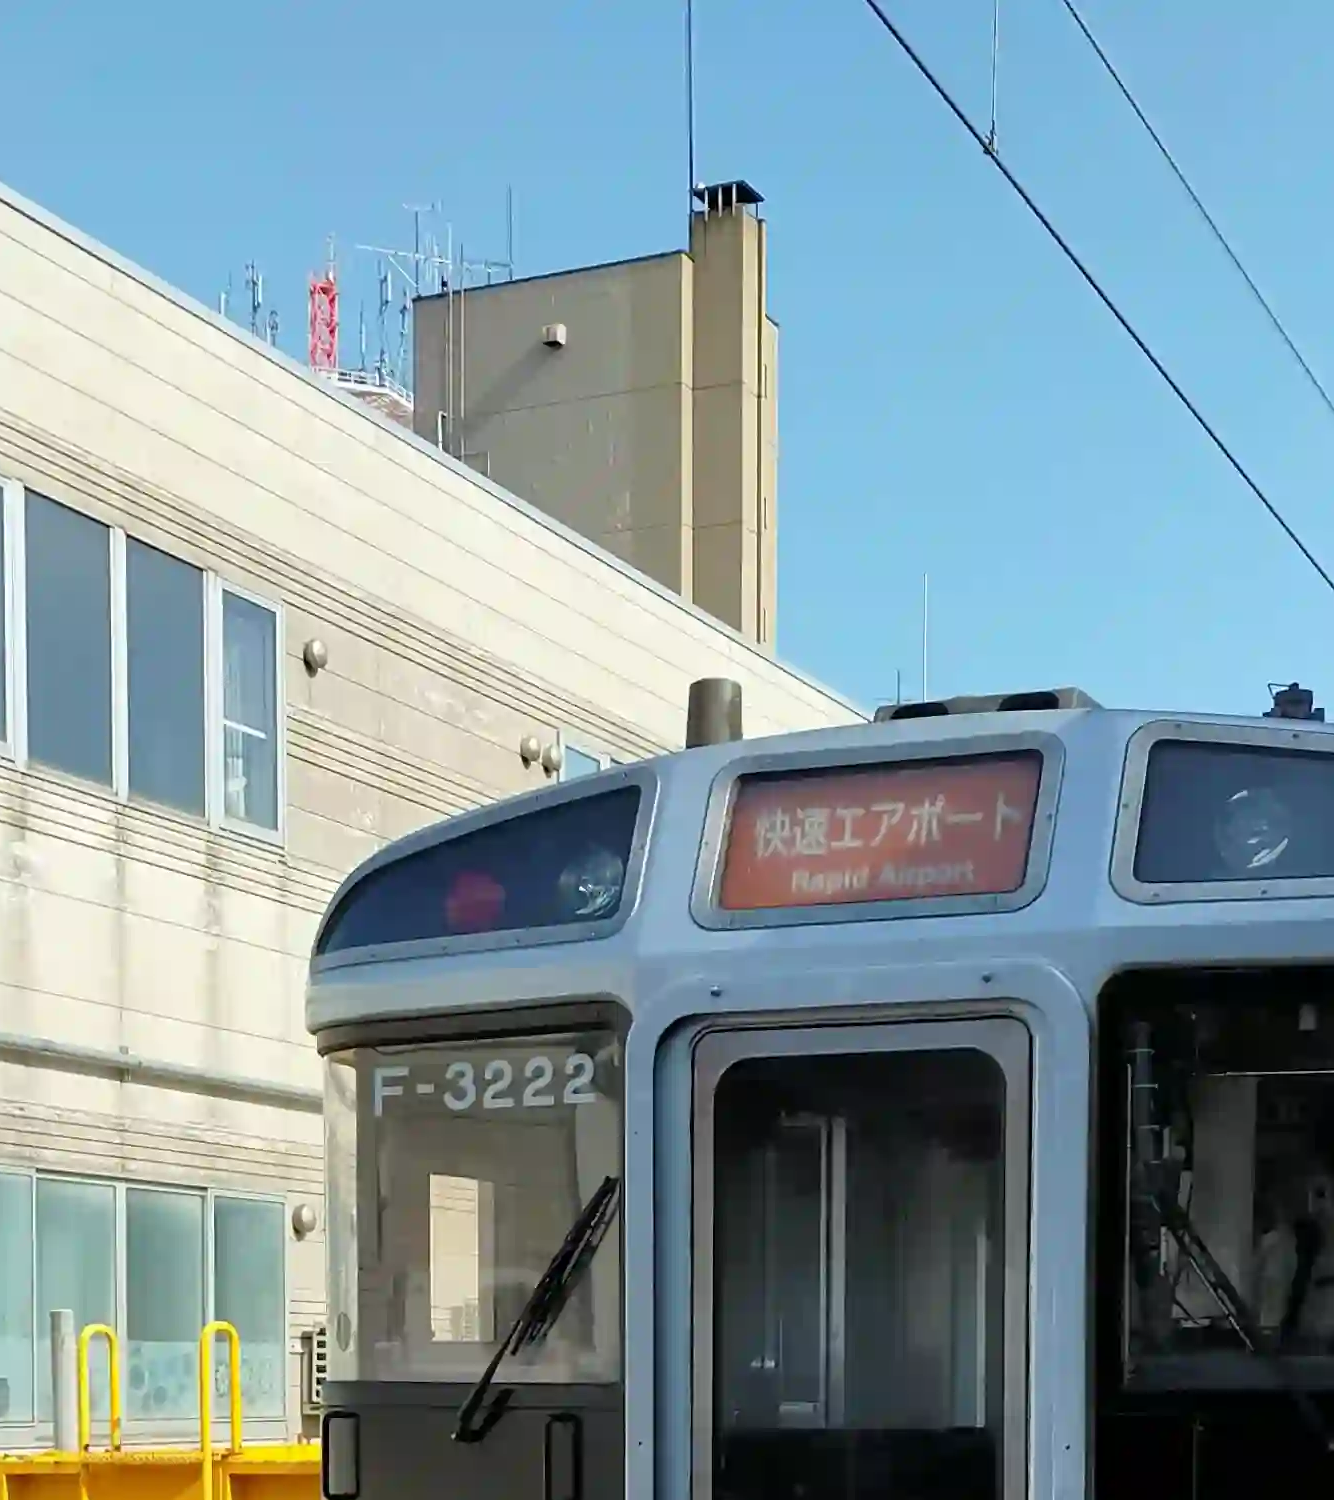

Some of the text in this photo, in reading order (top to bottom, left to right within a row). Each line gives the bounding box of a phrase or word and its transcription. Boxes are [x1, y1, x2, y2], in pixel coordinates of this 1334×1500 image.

[755, 793, 1022, 859] 快速エアポート
[792, 867, 869, 894] Rapid
[373, 1053, 597, 1117] F-3222
